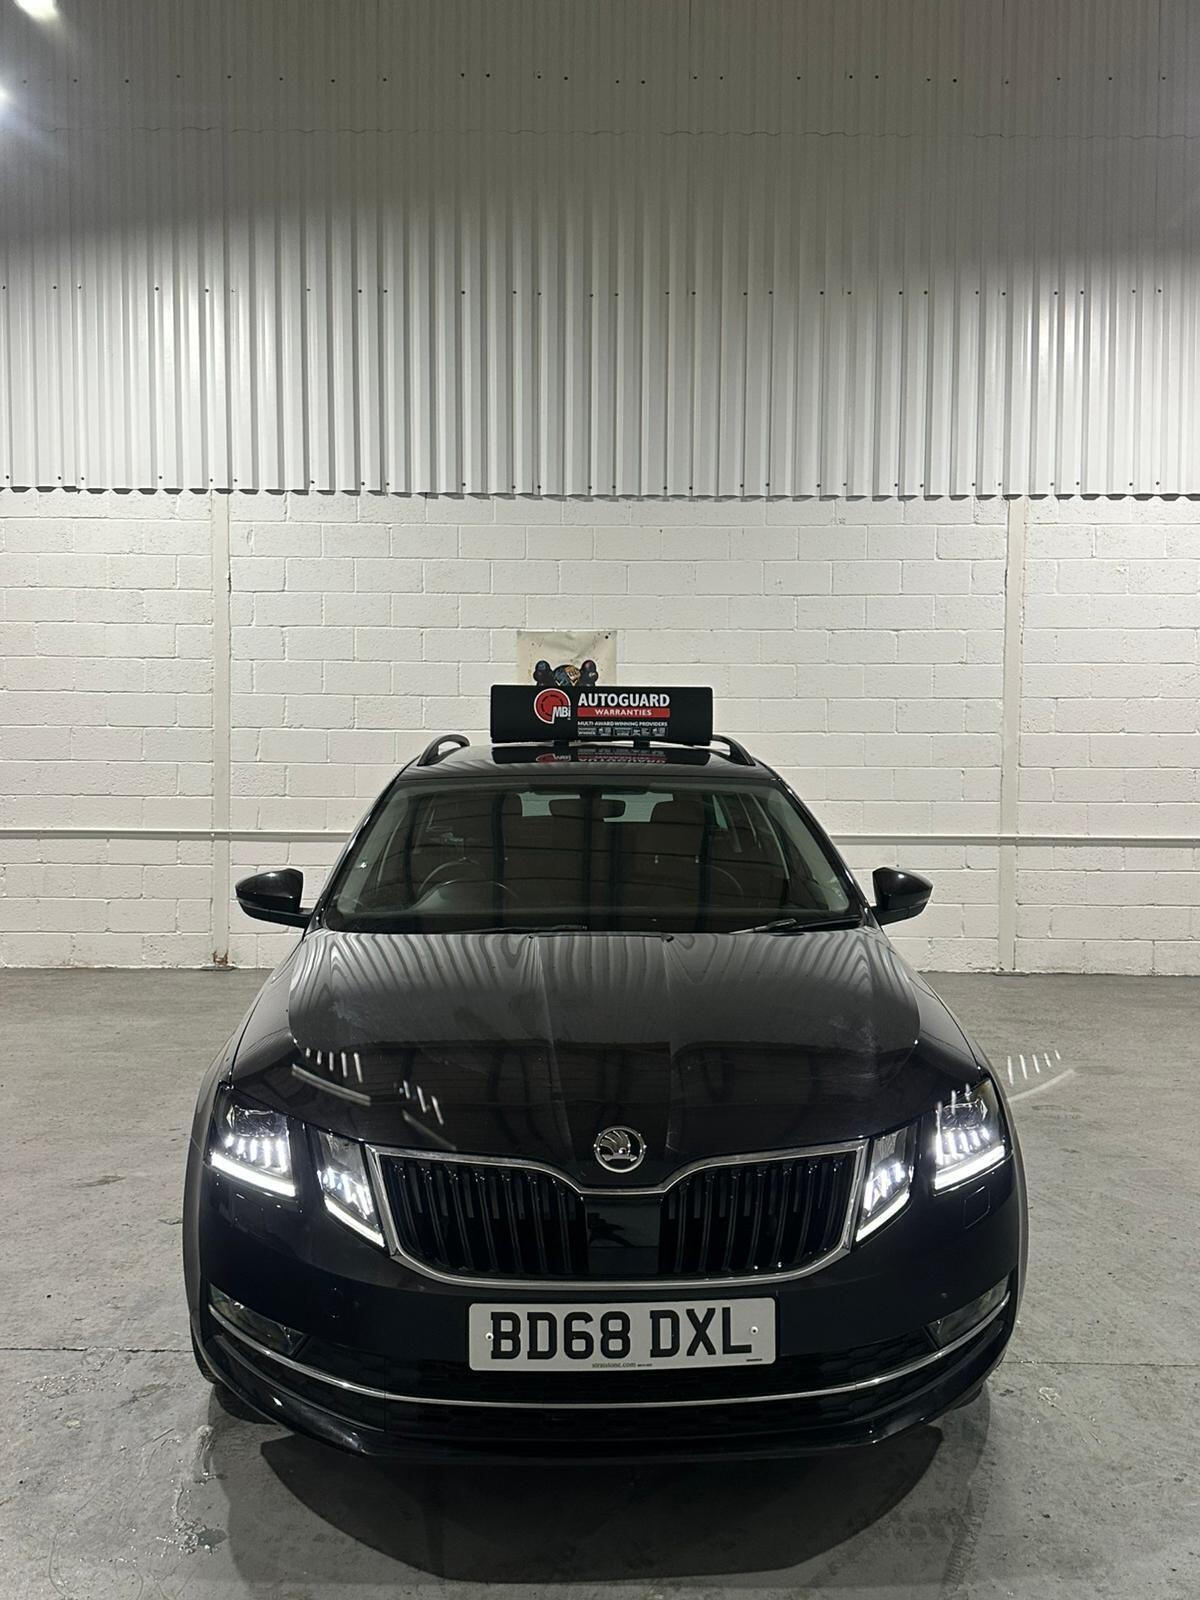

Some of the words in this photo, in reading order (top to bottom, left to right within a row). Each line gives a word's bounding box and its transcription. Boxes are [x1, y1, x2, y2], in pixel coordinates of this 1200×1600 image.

[577, 693, 671, 707] AUTOGUARD
[595, 708, 652, 716] WARRANTIES
[490, 1311, 631, 1360] BD68
[649, 1306, 753, 1358] DXL
